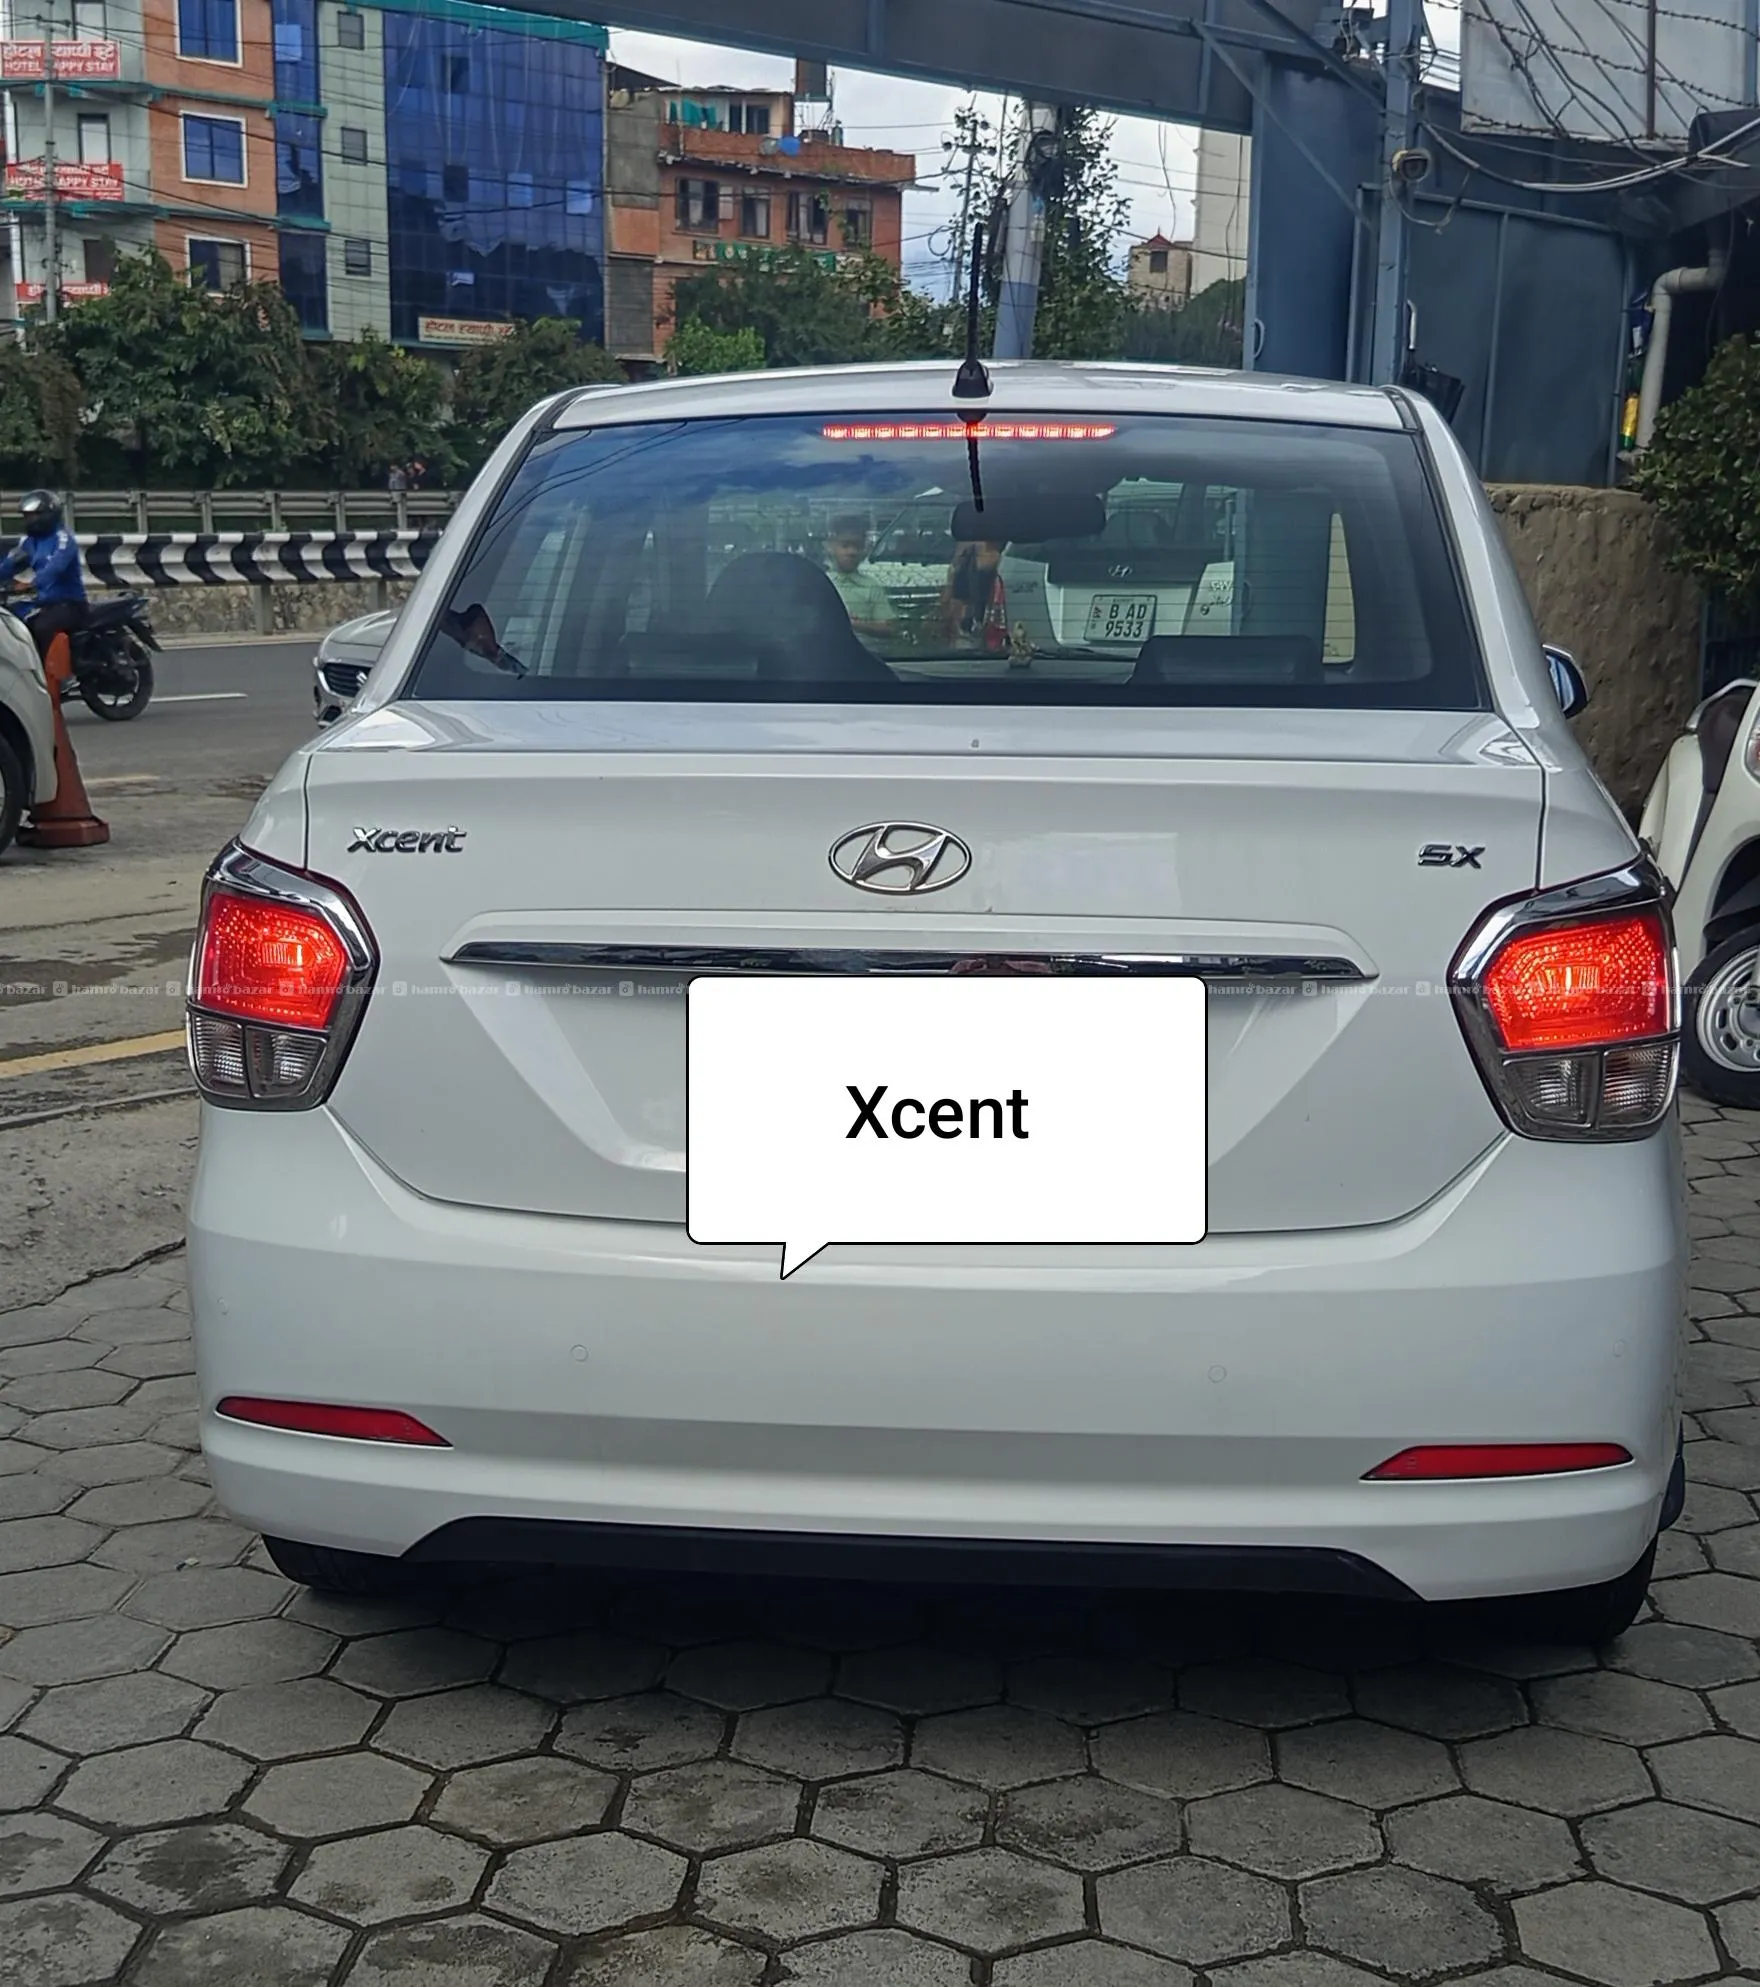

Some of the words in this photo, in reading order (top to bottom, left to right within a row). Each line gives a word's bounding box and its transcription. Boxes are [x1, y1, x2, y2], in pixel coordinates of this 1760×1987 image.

[4, 61, 42, 73] HOTEL
[52, 60, 84, 73] APPY
[85, 60, 115, 73] STAY
[1125, 603, 1147, 619] AD
[1105, 620, 1144, 638] 9533
[347, 825, 468, 853] Xcent
[1417, 844, 1486, 869] SX
